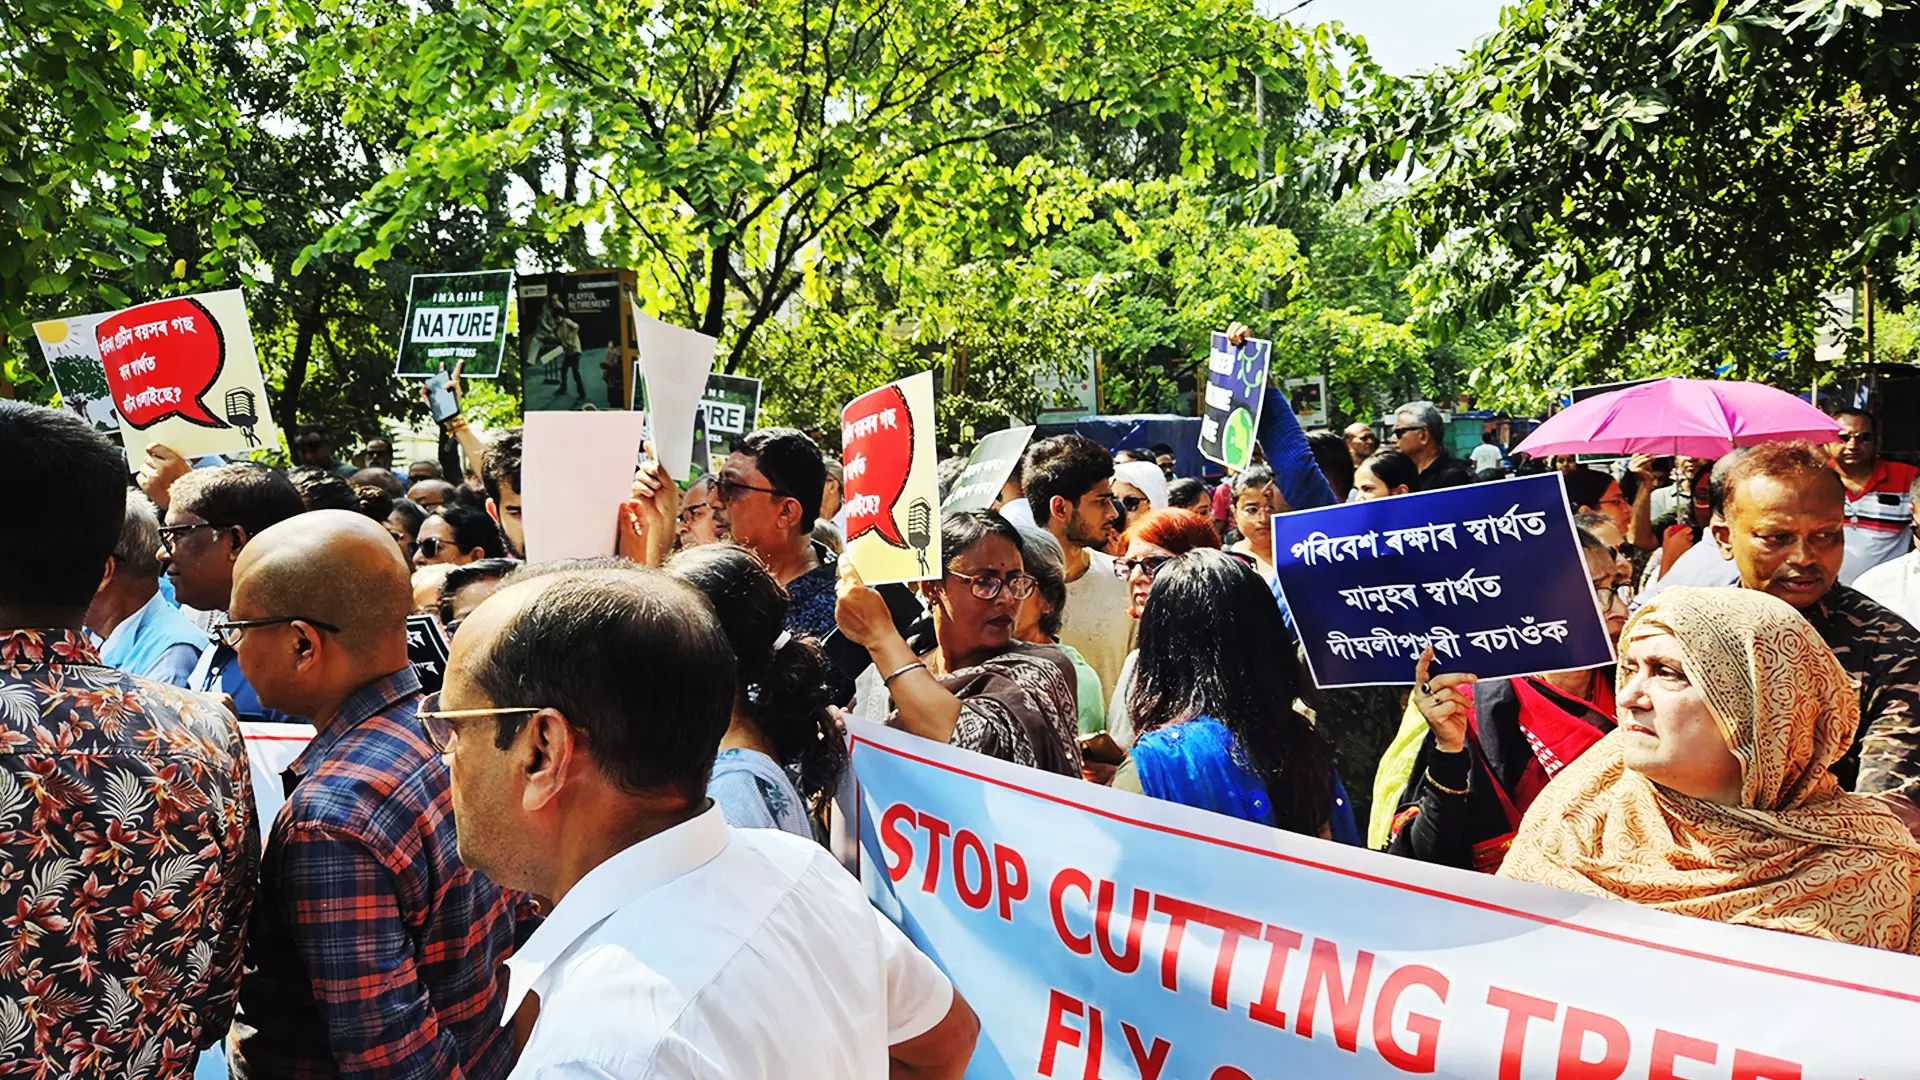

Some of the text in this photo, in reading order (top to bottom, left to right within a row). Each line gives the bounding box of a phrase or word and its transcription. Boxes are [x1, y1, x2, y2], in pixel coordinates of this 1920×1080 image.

[432, 291, 484, 303] IMAGINE
[568, 292, 596, 300] PLAYFUL
[568, 299, 610, 309] RETIREMENT
[171, 315, 197, 334] গছ
[417, 312, 495, 337] NATURE
[1290, 530, 1378, 566] পৰিবেশ
[1383, 522, 1457, 556] ৰক্ষাৰ
[1338, 583, 1419, 614] মানুহৰ
[880, 802, 1029, 920] STOP
[1049, 867, 1451, 1074] CUTTING
